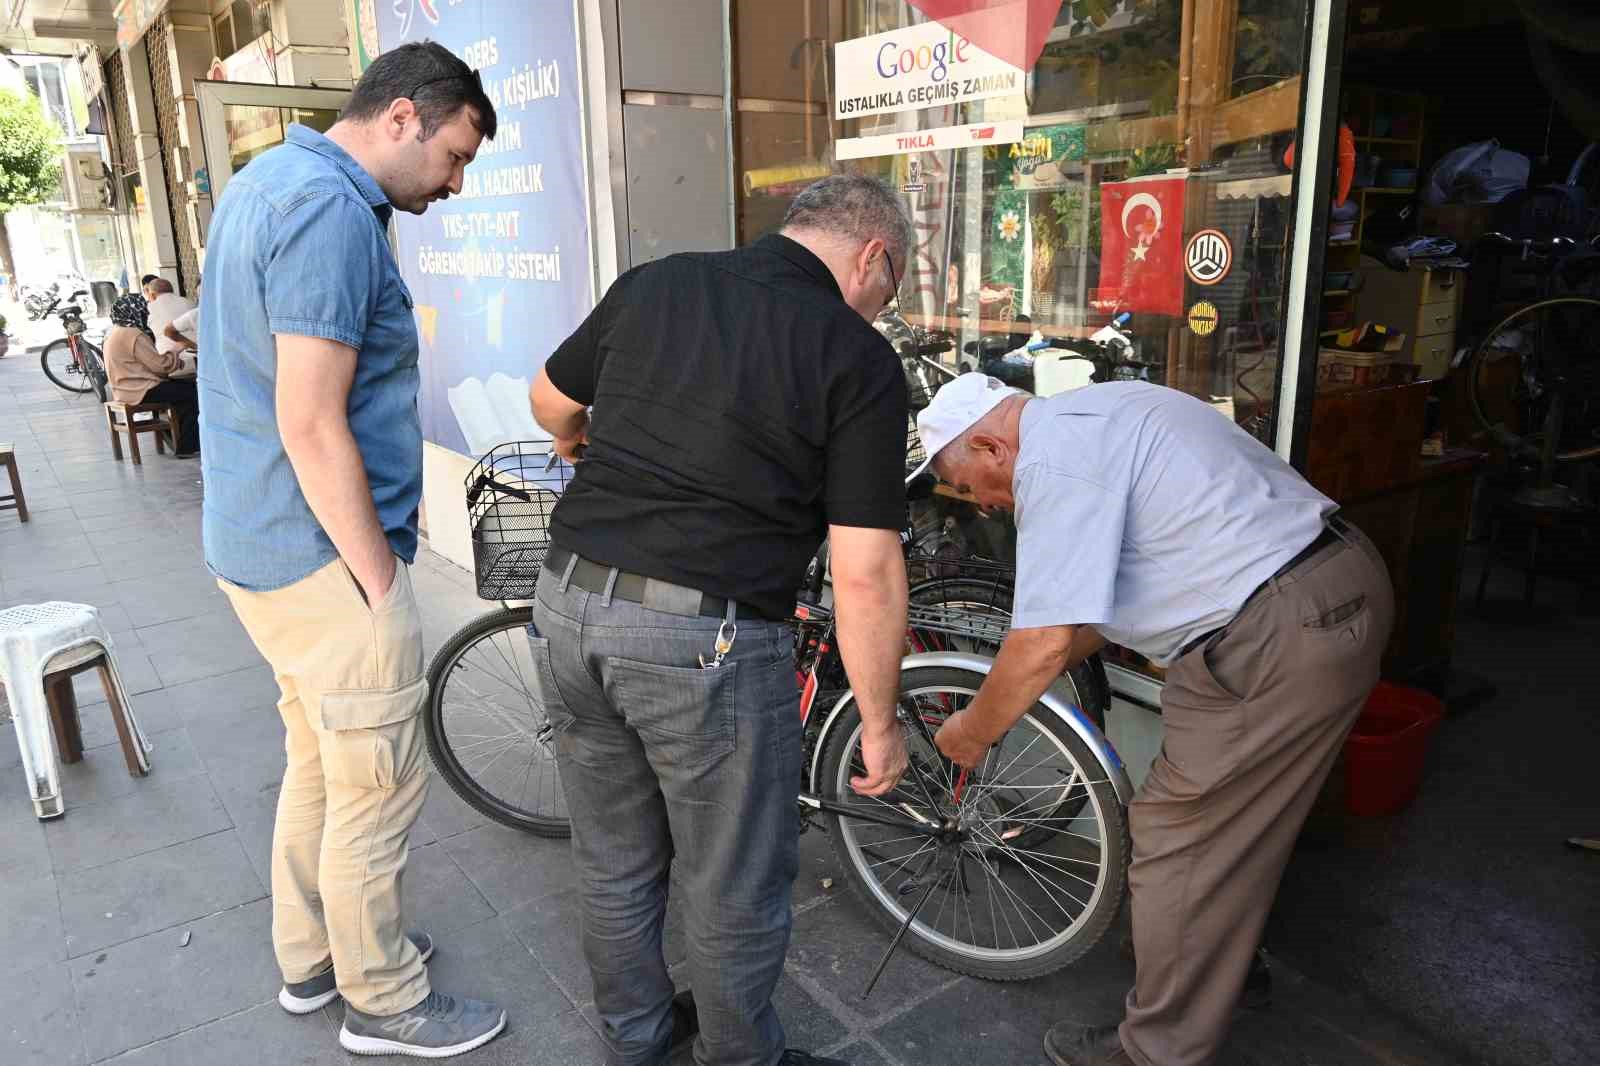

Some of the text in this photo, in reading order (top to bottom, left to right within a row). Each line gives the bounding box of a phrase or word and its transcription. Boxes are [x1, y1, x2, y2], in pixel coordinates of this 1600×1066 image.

[464, 36, 498, 71] DERS
[876, 30, 969, 82] Google
[839, 71, 1016, 114] USTALIKLA GEÇMİŞ ZAMAN
[896, 135, 935, 150] TIKLA
[483, 163, 544, 197] HAZIRLIK
[507, 245, 560, 281] SİSTEMİ
